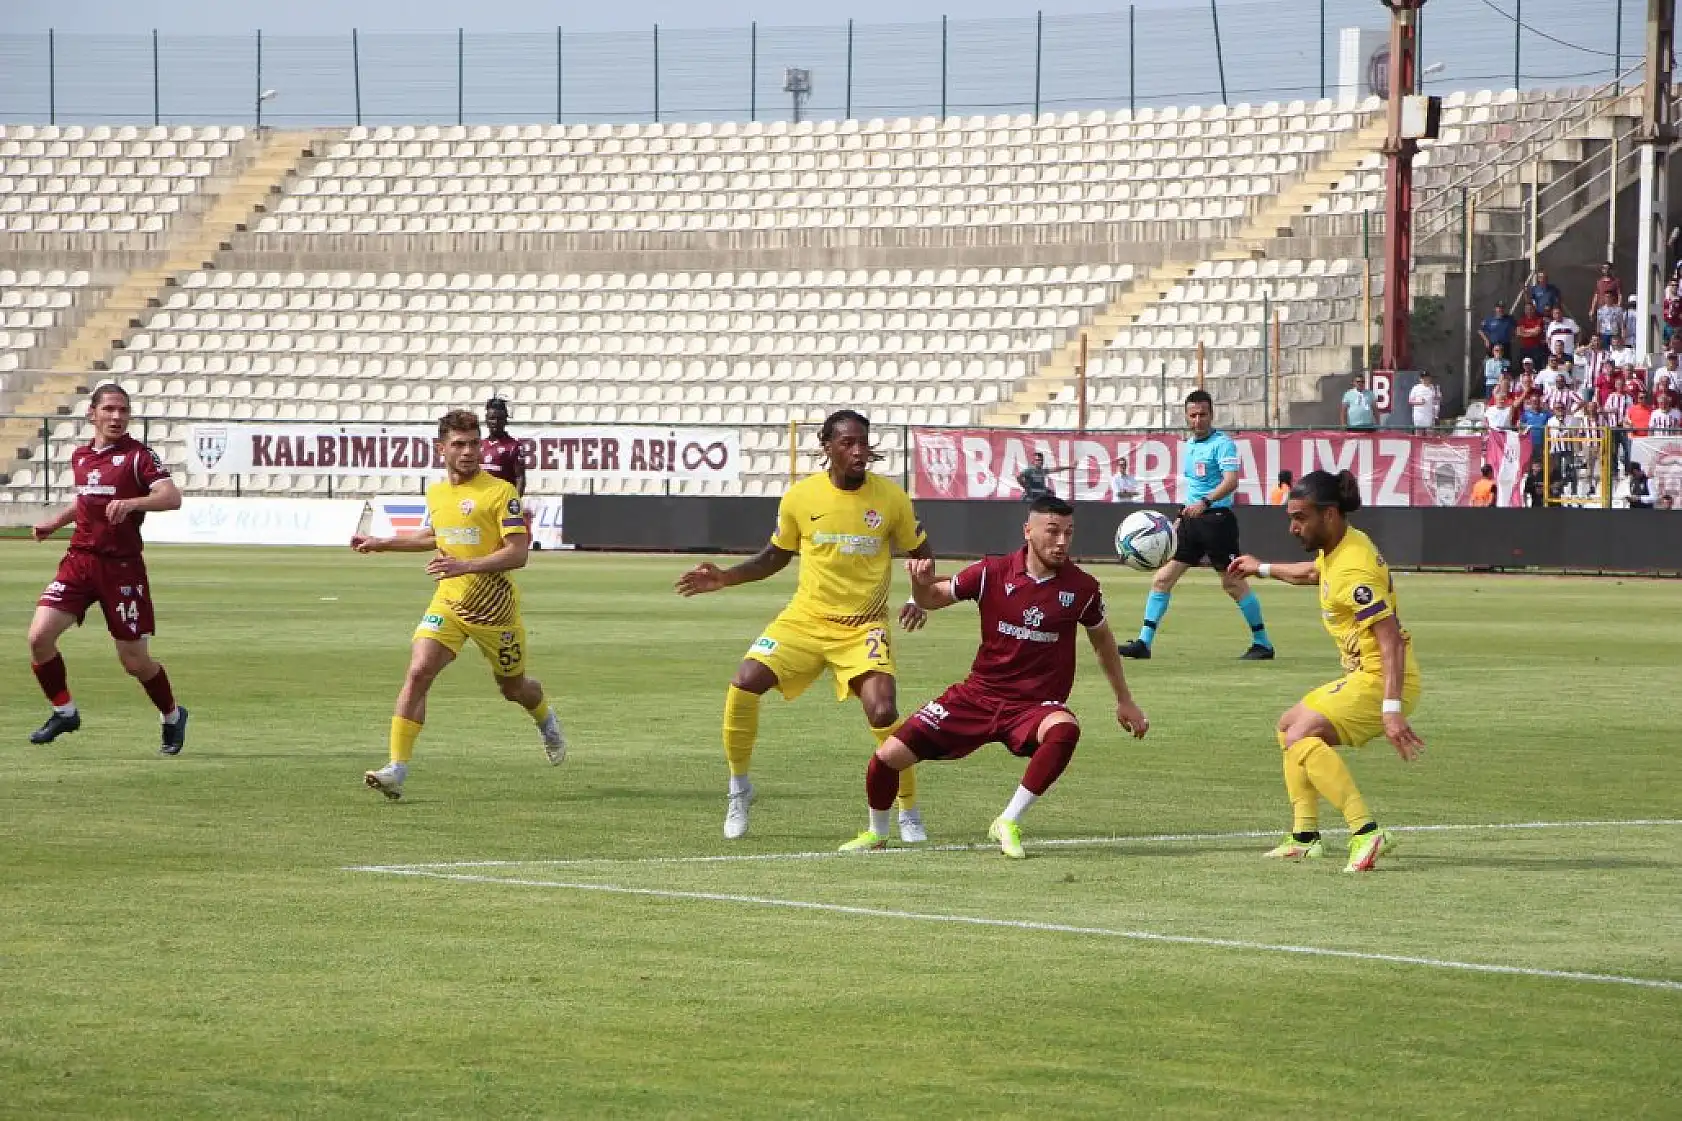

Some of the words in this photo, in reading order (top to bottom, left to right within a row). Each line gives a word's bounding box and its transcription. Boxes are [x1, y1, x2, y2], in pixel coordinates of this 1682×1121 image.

[1372, 375, 1390, 409] B
[252, 427, 450, 468] KALBİMİZDE
[519, 437, 620, 470] BETER
[630, 430, 676, 472] ABİ
[962, 436, 1411, 506] BANDIRALIYIZ
[116, 601, 139, 622] 14
[499, 643, 520, 667] 53
